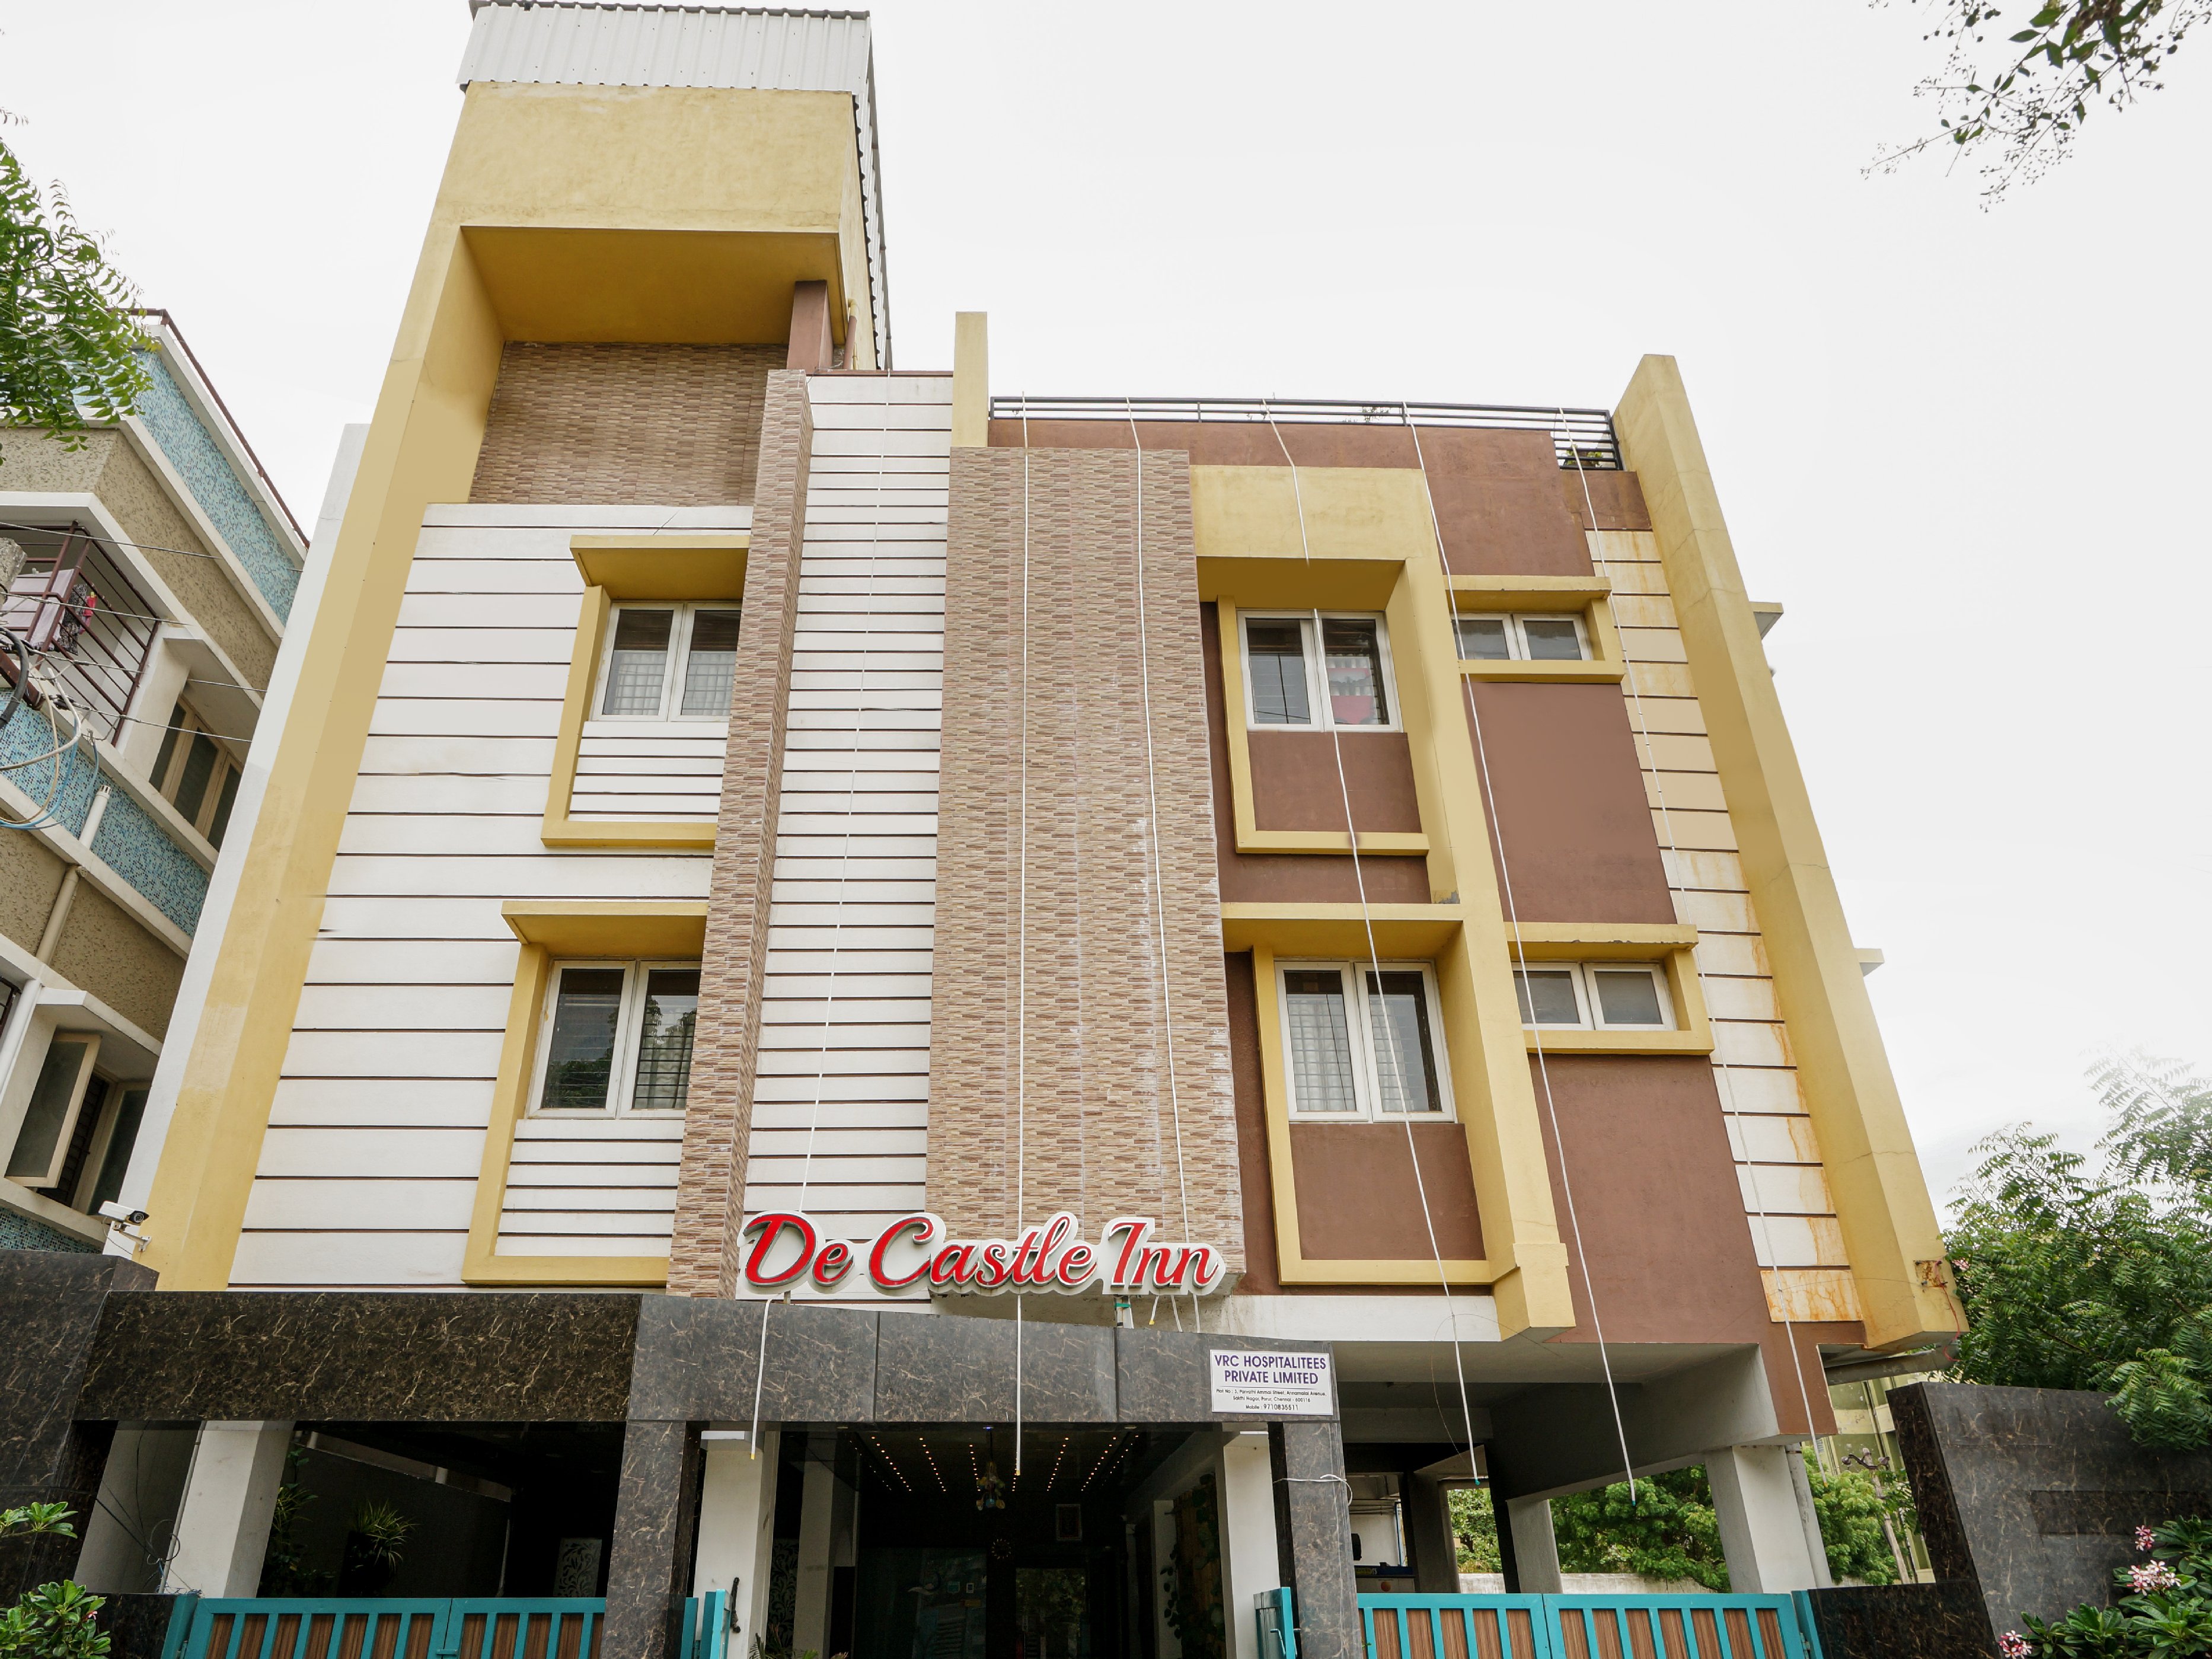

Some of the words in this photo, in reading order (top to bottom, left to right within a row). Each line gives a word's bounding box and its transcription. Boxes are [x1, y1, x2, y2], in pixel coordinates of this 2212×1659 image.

[741, 1210, 854, 1288] De
[868, 1211, 1097, 1289] Castle
[1108, 1221, 1221, 1285] Inn
[1214, 1355, 1239, 1367] VRC
[1244, 1355, 1326, 1369] HOSPITALITEES
[1224, 1370, 1269, 1383] PRIVATE
[1273, 1371, 1319, 1384] LIMITED
